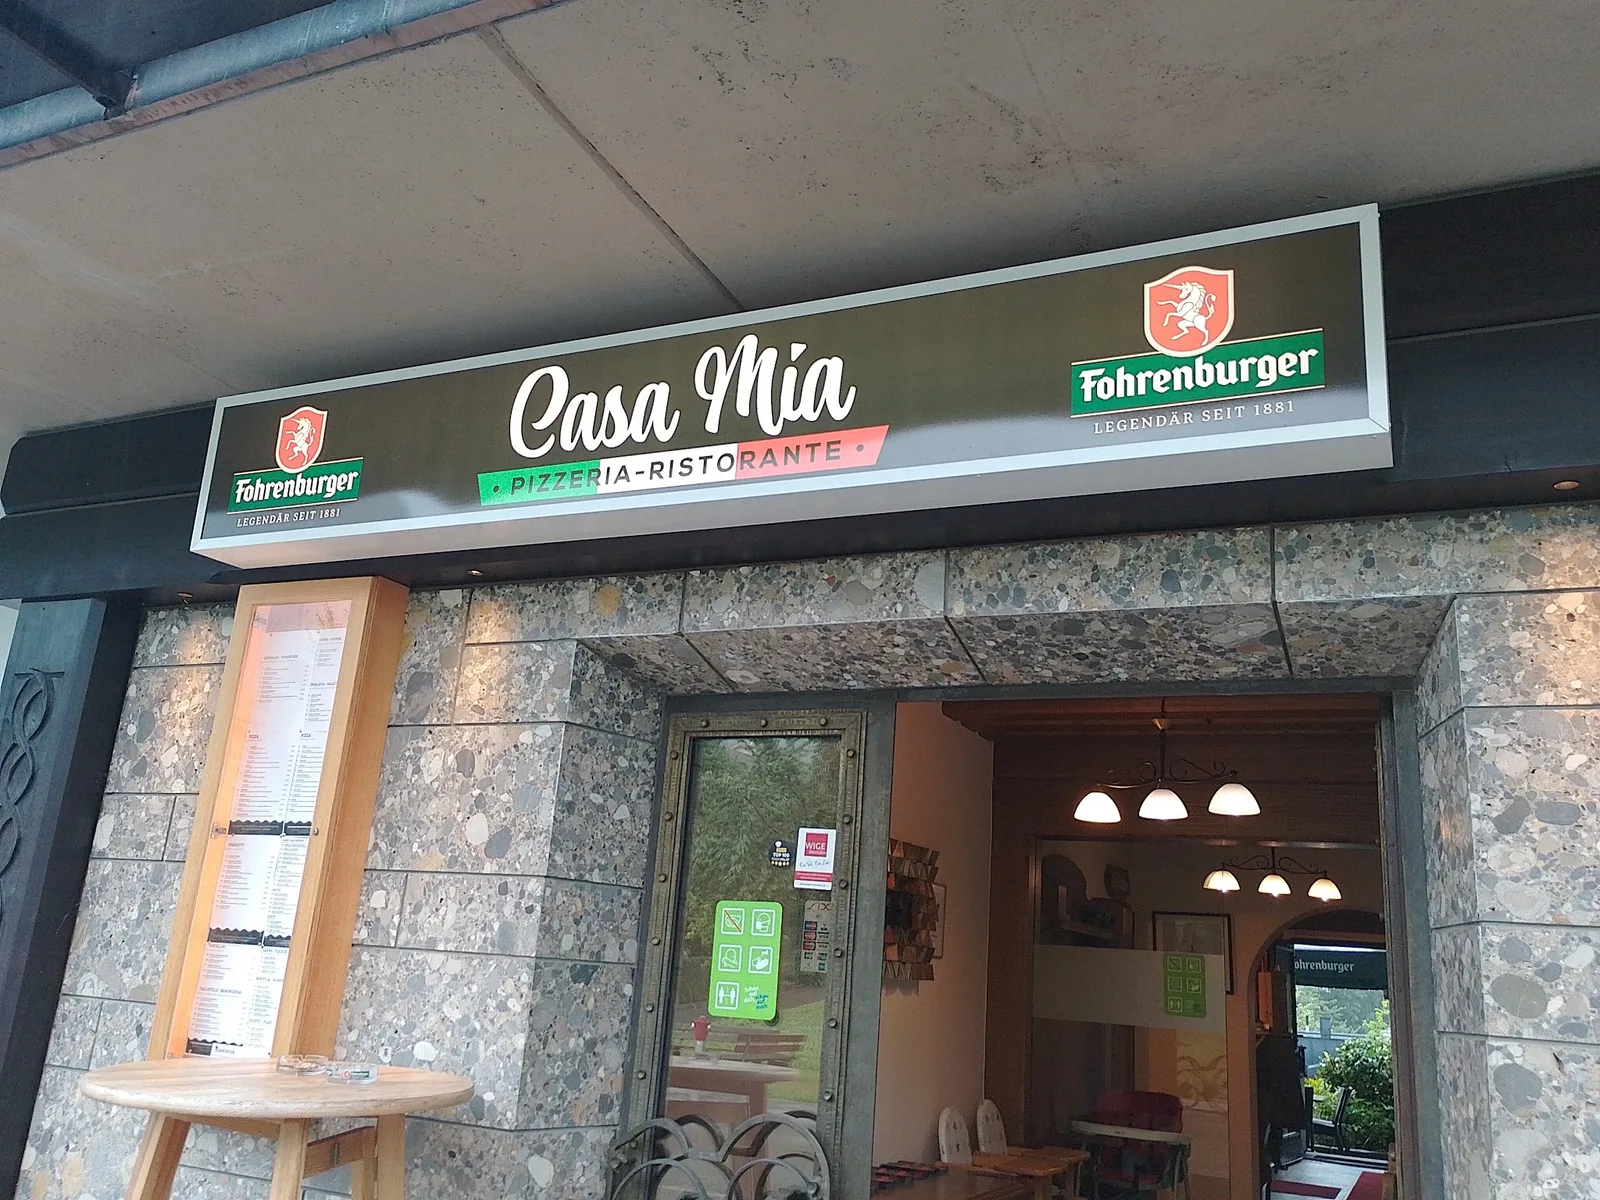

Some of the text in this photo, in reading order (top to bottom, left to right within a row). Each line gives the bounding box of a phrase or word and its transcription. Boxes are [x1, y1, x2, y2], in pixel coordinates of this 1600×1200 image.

[1079, 348, 1319, 402] Fohrenburger
[508, 333, 858, 459] Casa Mia
[1093, 400, 1295, 434] LEGENDÄR SEIT 1881
[511, 439, 843, 496] PIZZERIA-RISTORANTE
[235, 472, 359, 502] Fohrenburger
[236, 507, 341, 527] LEGENDÄR SEIT 1881
[805, 841, 826, 851] WIGE
[1294, 958, 1355, 973] ohrenburger
